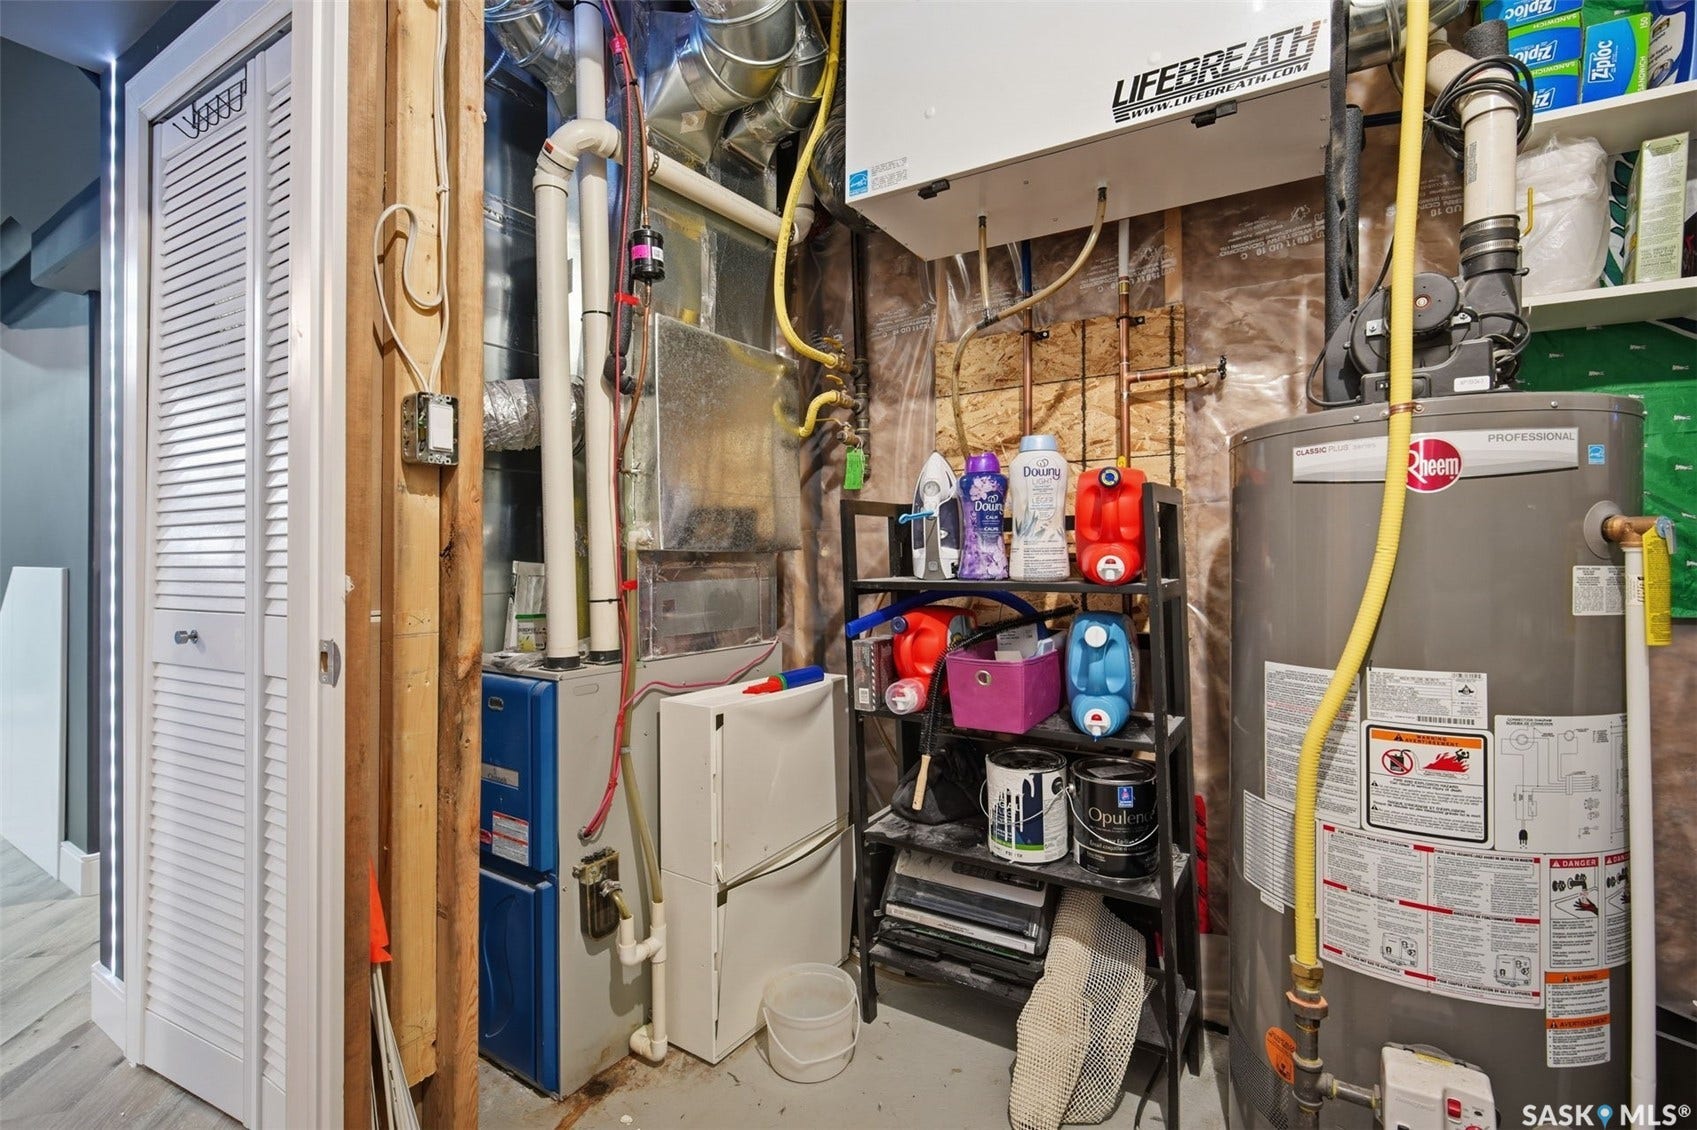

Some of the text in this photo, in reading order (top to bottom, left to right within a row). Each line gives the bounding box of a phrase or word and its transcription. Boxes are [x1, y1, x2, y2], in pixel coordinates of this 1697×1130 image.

[1533, 14, 1578, 29] SANDWICH
[1509, 44, 1552, 64] Ziplo
[1591, 40, 1615, 80] Ziploc
[1112, 20, 1321, 108] LIFEBREATH
[1130, 62, 1310, 119] WWW.LIFEBREATH.COM
[1487, 432, 1575, 443] PROFESSIONAL
[1295, 446, 1328, 457] CLASSIC
[1328, 443, 1349, 453] PLUS
[1405, 440, 1459, 484] Rheem
[1023, 466, 1061, 481] Downy
[1416, 734, 1448, 742] WARNING
[1562, 859, 1597, 868] DANGER
